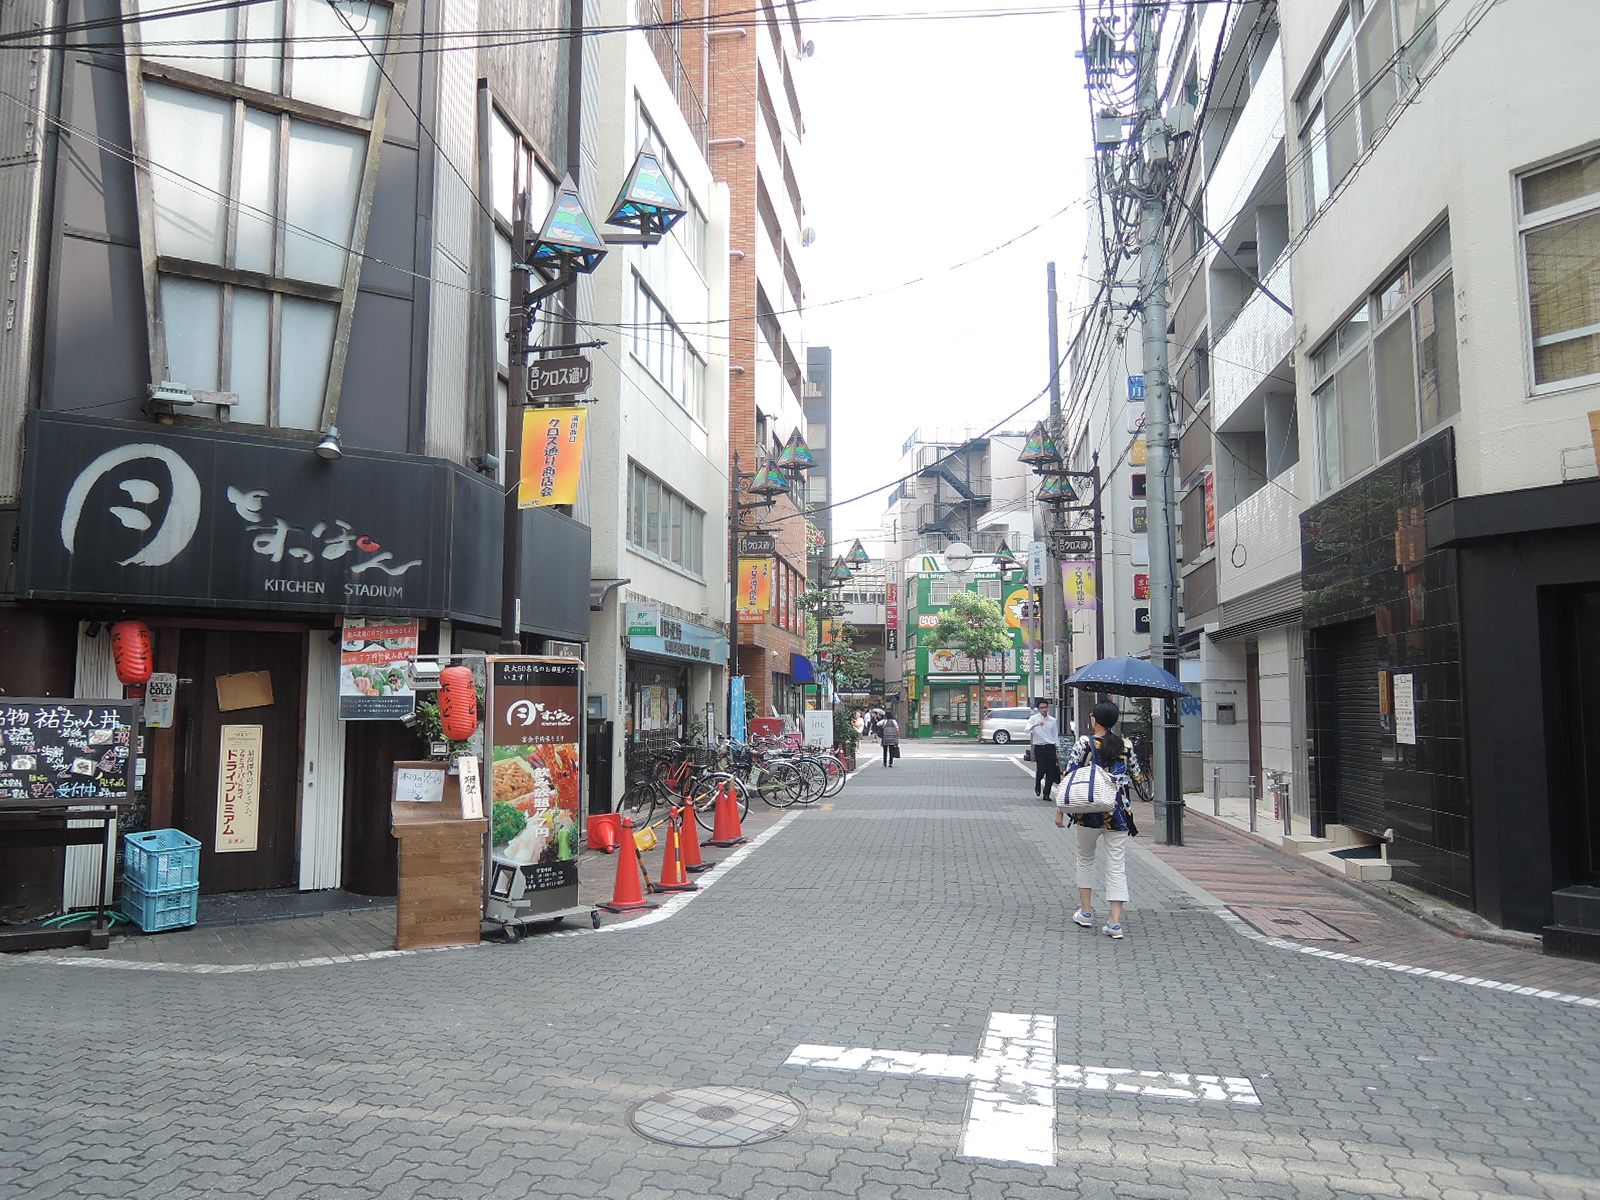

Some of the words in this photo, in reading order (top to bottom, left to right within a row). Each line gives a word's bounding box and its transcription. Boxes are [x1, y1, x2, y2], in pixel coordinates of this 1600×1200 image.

[530, 366, 540, 391] 西口
[540, 366, 589, 387] クロス通り
[264, 578, 325, 595] KITCHEN
[343, 582, 403, 598] STADIUM
[149, 687, 172, 696] COLD
[222, 749, 238, 836] ドライプレミアム
